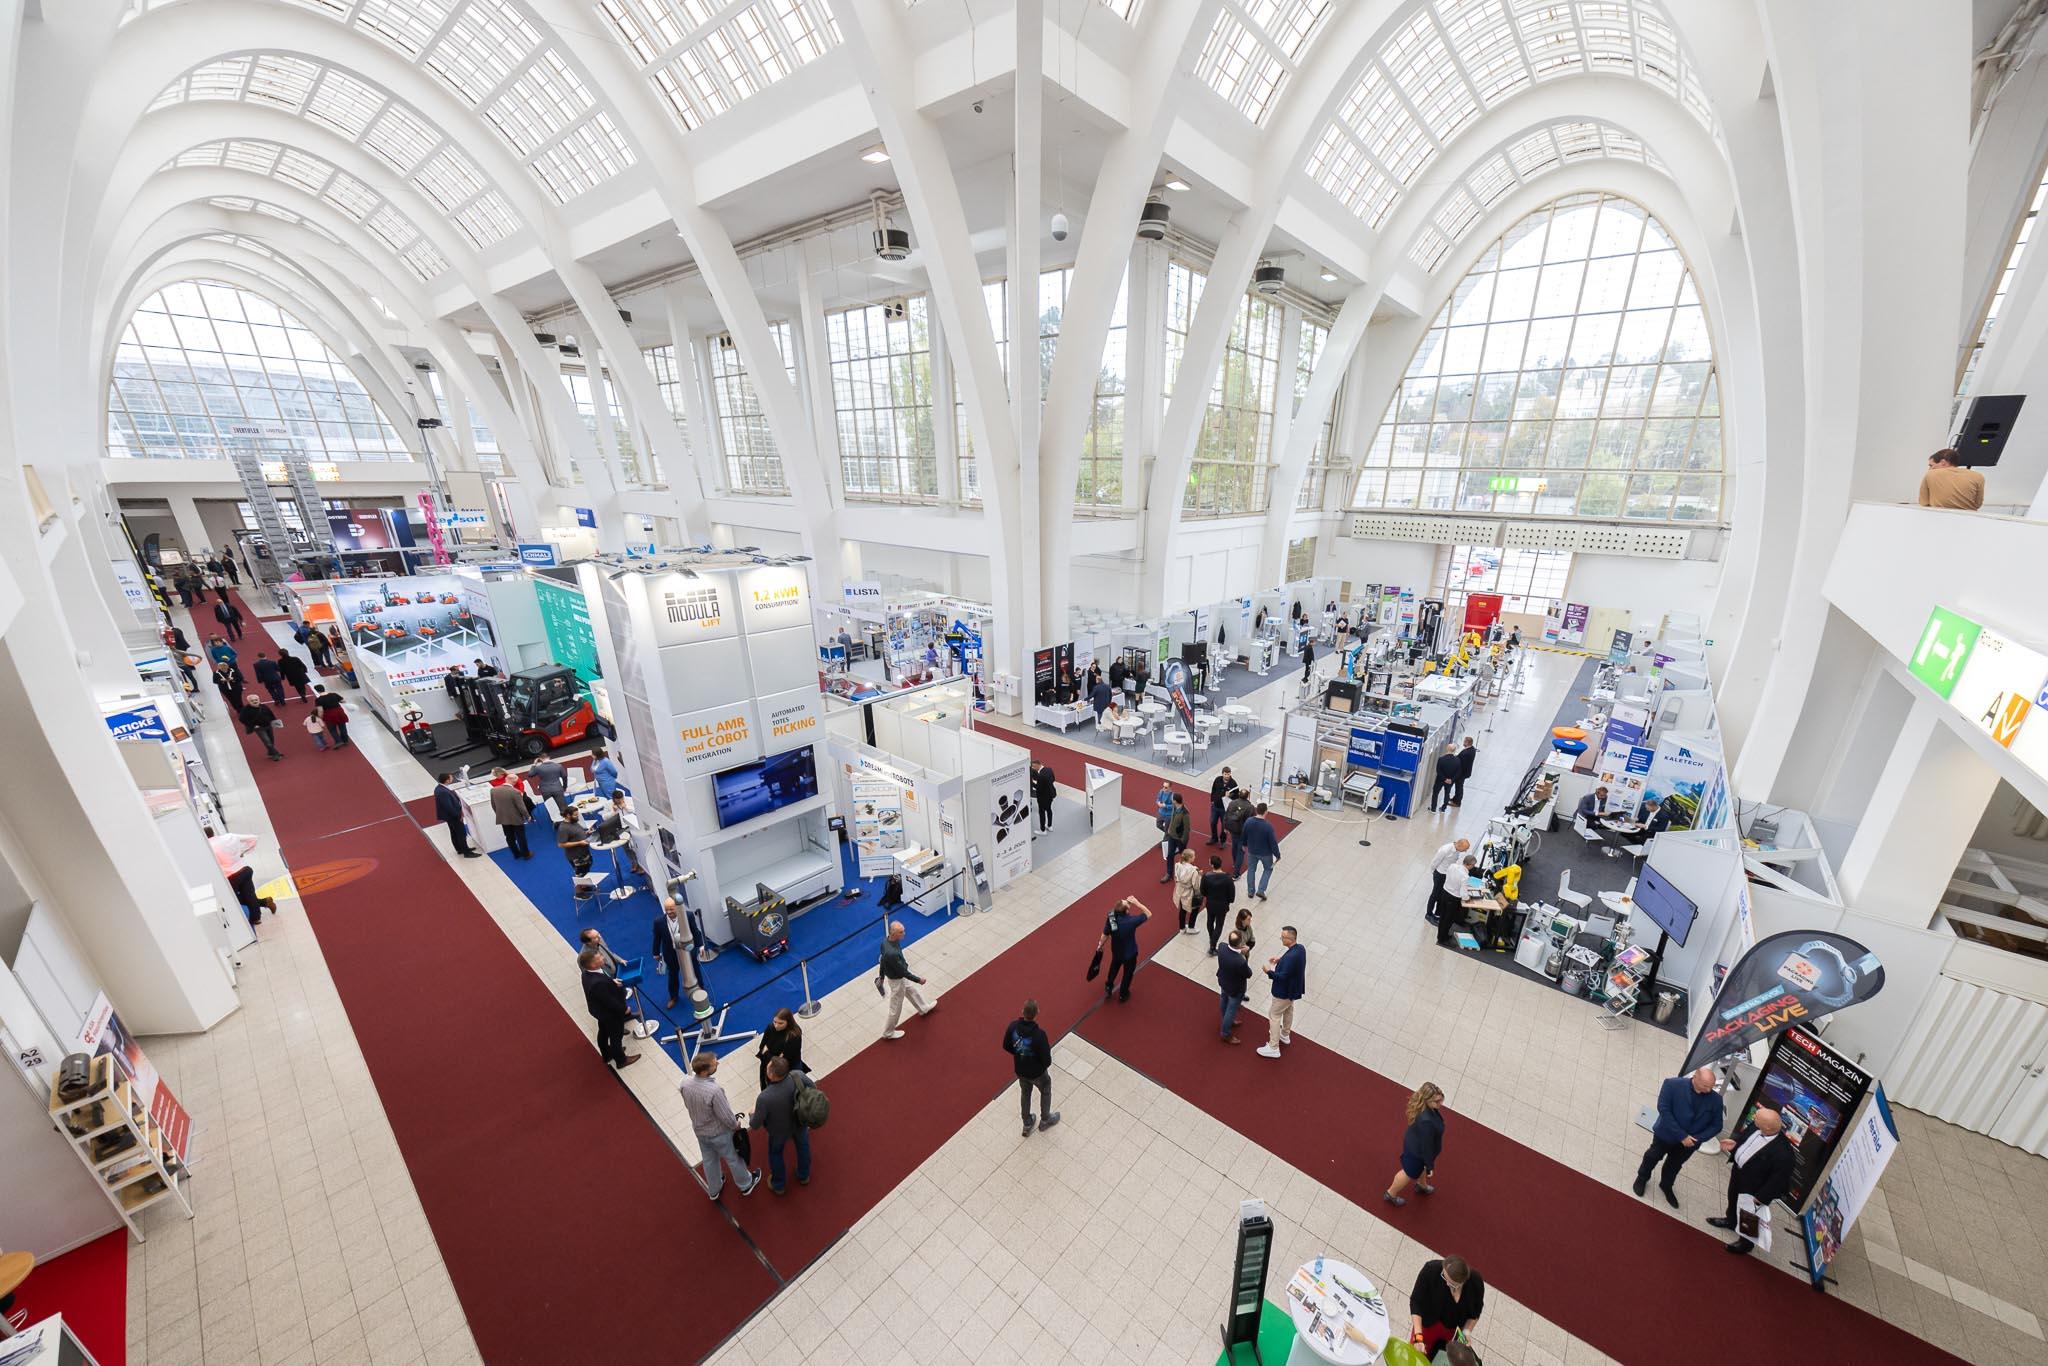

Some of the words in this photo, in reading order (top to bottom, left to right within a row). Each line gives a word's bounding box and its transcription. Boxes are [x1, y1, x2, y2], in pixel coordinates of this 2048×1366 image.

[853, 588, 880, 596] LISTA
[667, 601, 720, 623] MODULA
[754, 599, 799, 610] CONSUMPTION
[702, 618, 720, 628] LIFT
[771, 704, 805, 718] AUTOMATED
[682, 726, 713, 741] FULL
[716, 716, 746, 733] AMR
[772, 717, 790, 726] TOTES
[772, 716, 816, 737] PICKING
[685, 742, 705, 754] and
[707, 728, 750, 748] COBOT
[686, 746, 732, 763] INTEGRATION
[1664, 755, 1704, 767] KALETECH
[1783, 965, 1814, 985] PACKAGING
[1790, 974, 1803, 984] LIVE
[1704, 994, 1799, 1045] PACKAGING
[1754, 1002, 1809, 1033] LIVE
[21, 1049, 40, 1060] A2
[25, 1057, 42, 1067] 29
[1790, 1029, 1816, 1052] TECH
[1816, 1049, 1863, 1085] MAGAZÍN
[1867, 1117, 1882, 1153] herald
